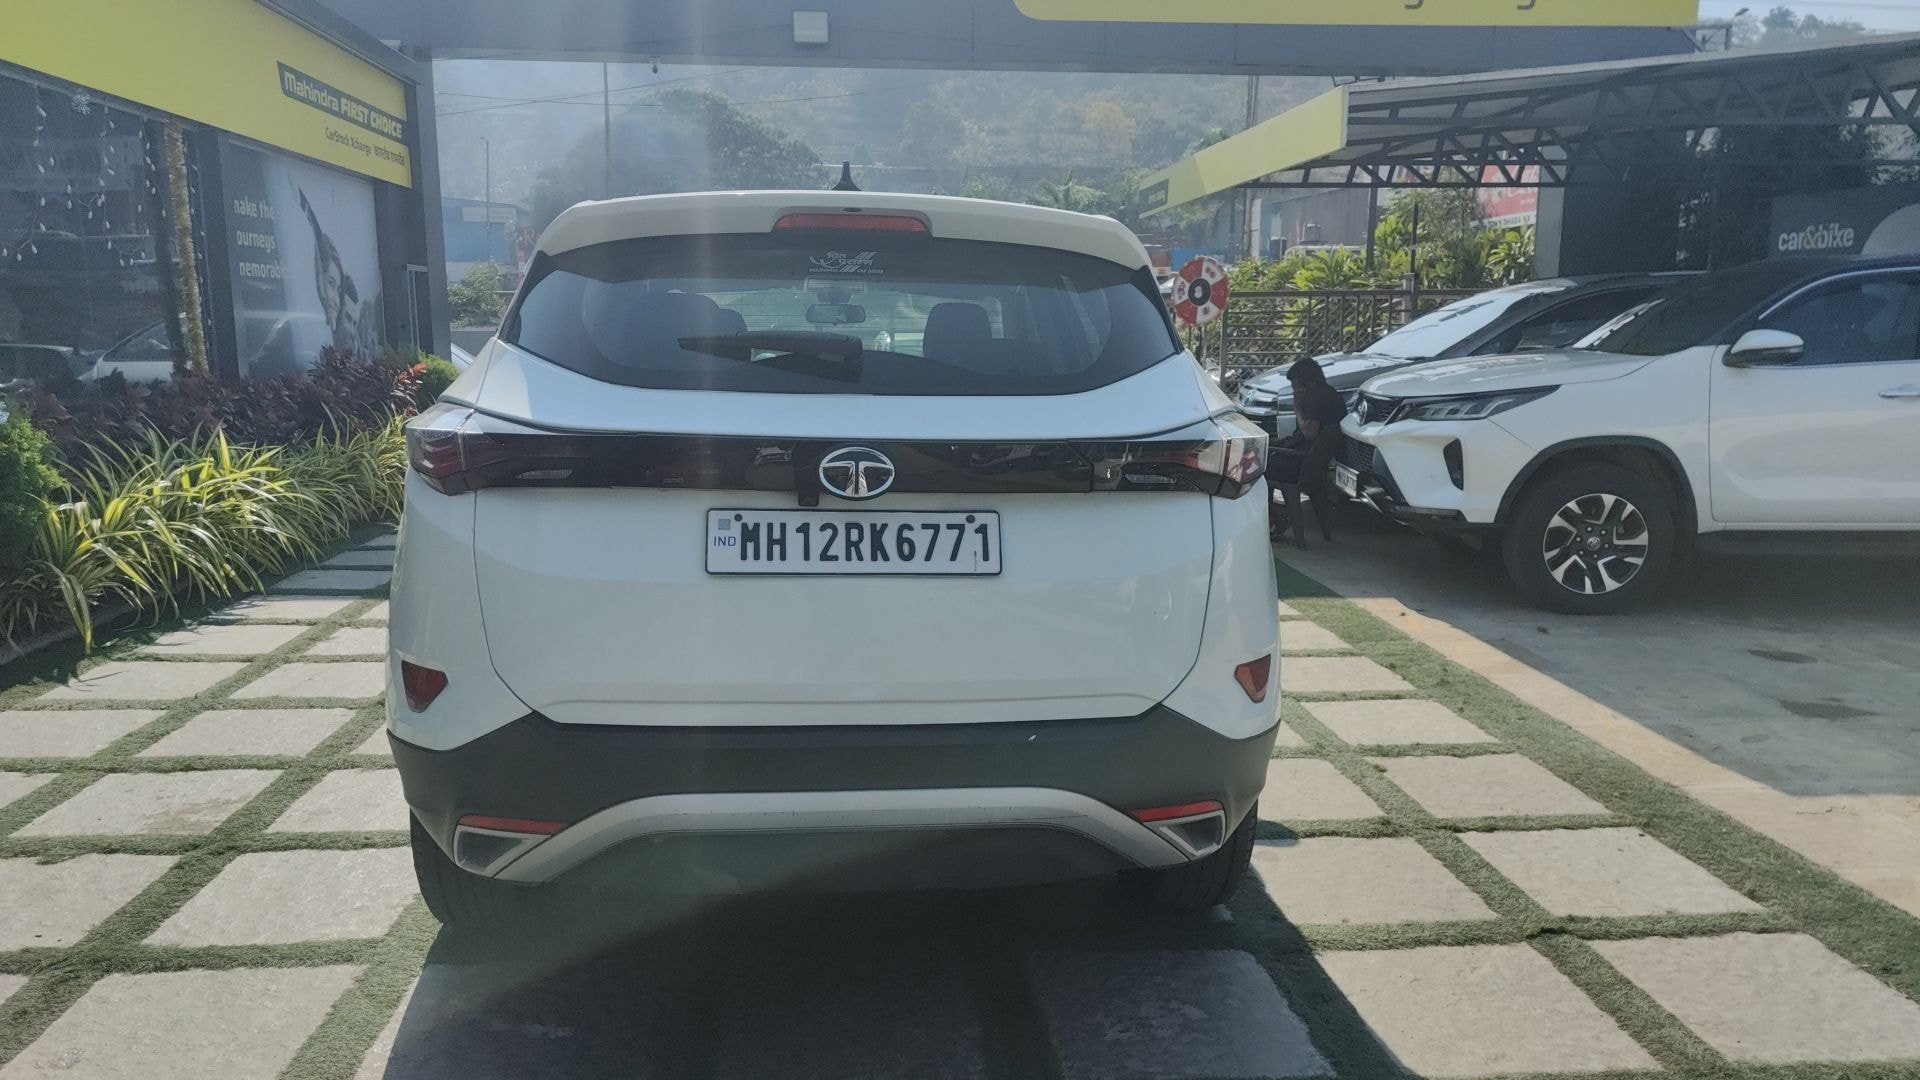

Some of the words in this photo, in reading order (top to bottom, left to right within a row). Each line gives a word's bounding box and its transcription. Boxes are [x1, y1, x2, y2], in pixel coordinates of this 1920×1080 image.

[284, 71, 339, 112] Mahindra
[340, 97, 370, 125] FIRST
[370, 111, 403, 140] CHOICE
[1778, 222, 1855, 251] car&bike
[713, 535, 737, 547] IND
[740, 521, 990, 561] MH12RK6771
